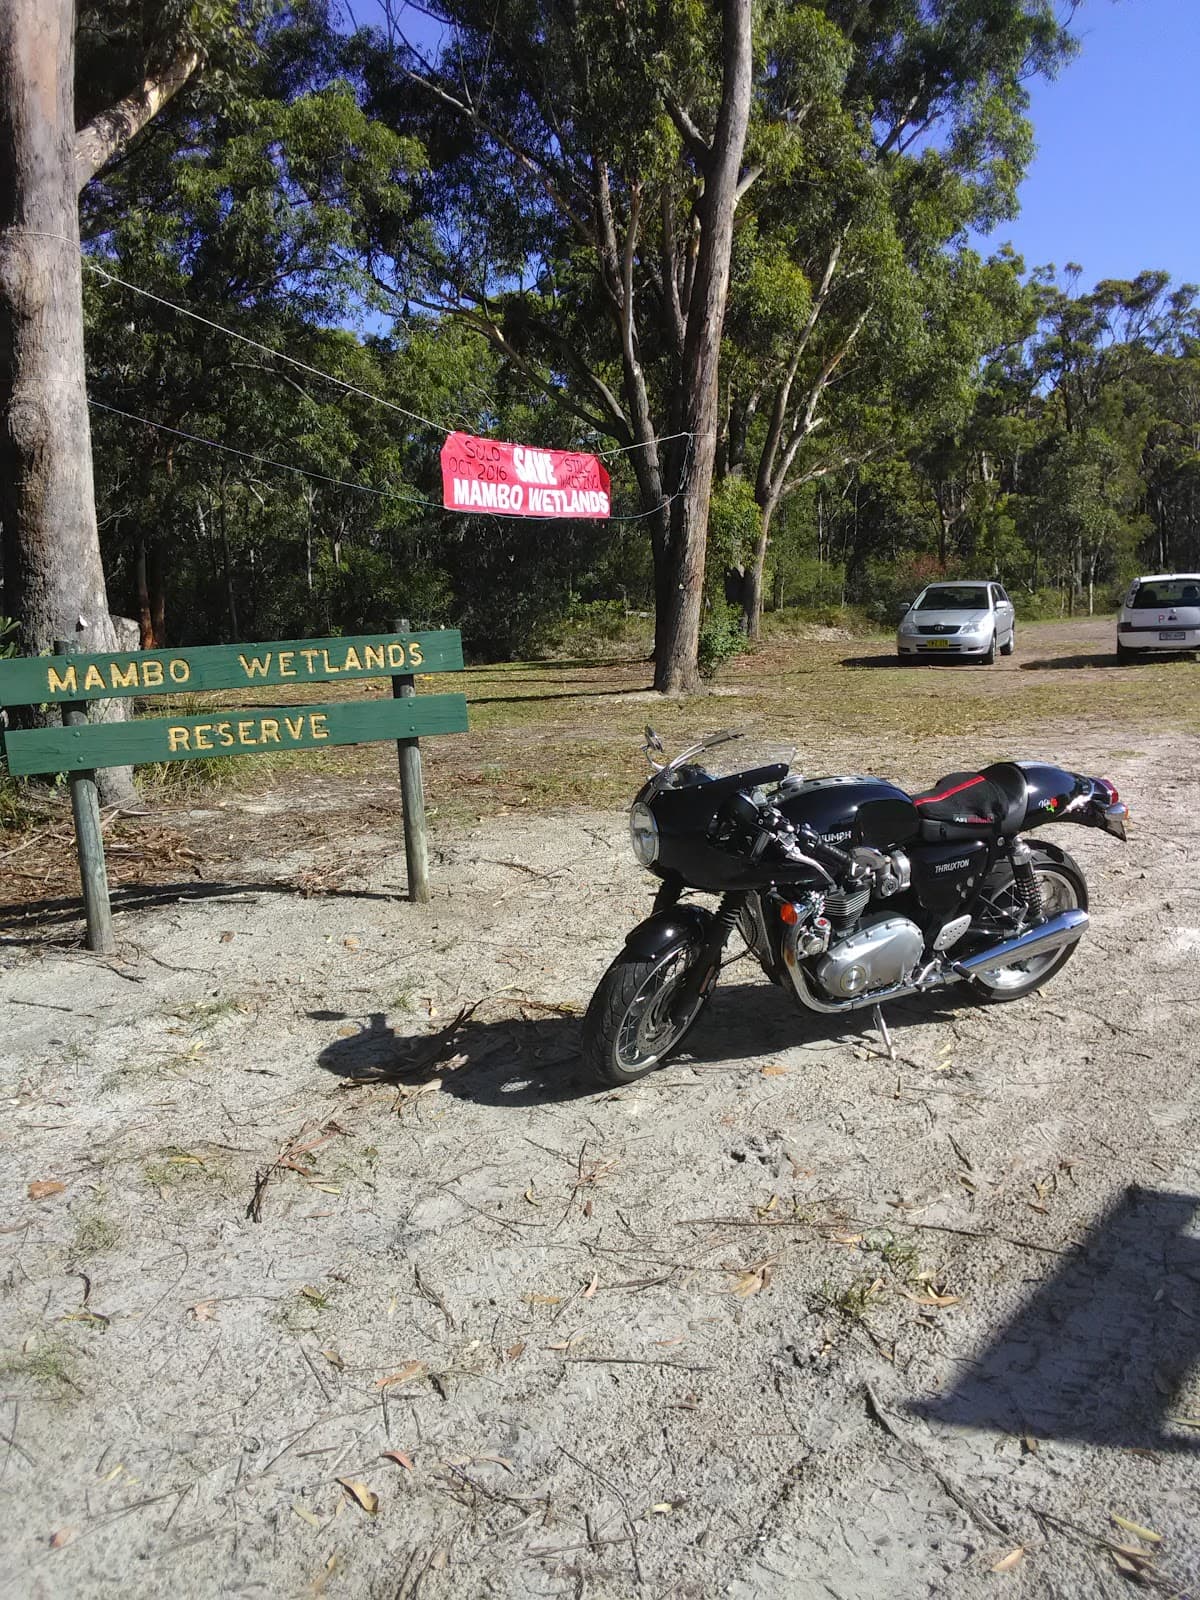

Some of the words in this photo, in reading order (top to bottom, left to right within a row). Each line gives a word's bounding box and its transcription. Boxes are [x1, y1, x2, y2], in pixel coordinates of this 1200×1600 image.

[448, 456, 472, 476] OCT
[477, 463, 508, 481] 2016
[464, 440, 501, 461] SOLD
[513, 447, 557, 486] SAVE
[453, 478, 524, 512] MAMBO
[528, 487, 610, 514] WETLANDS
[47, 658, 191, 694] MAMBO
[238, 641, 425, 679] WETLANDS
[167, 712, 330, 753] RESERVE
[934, 858, 970, 873] THRUXTON
